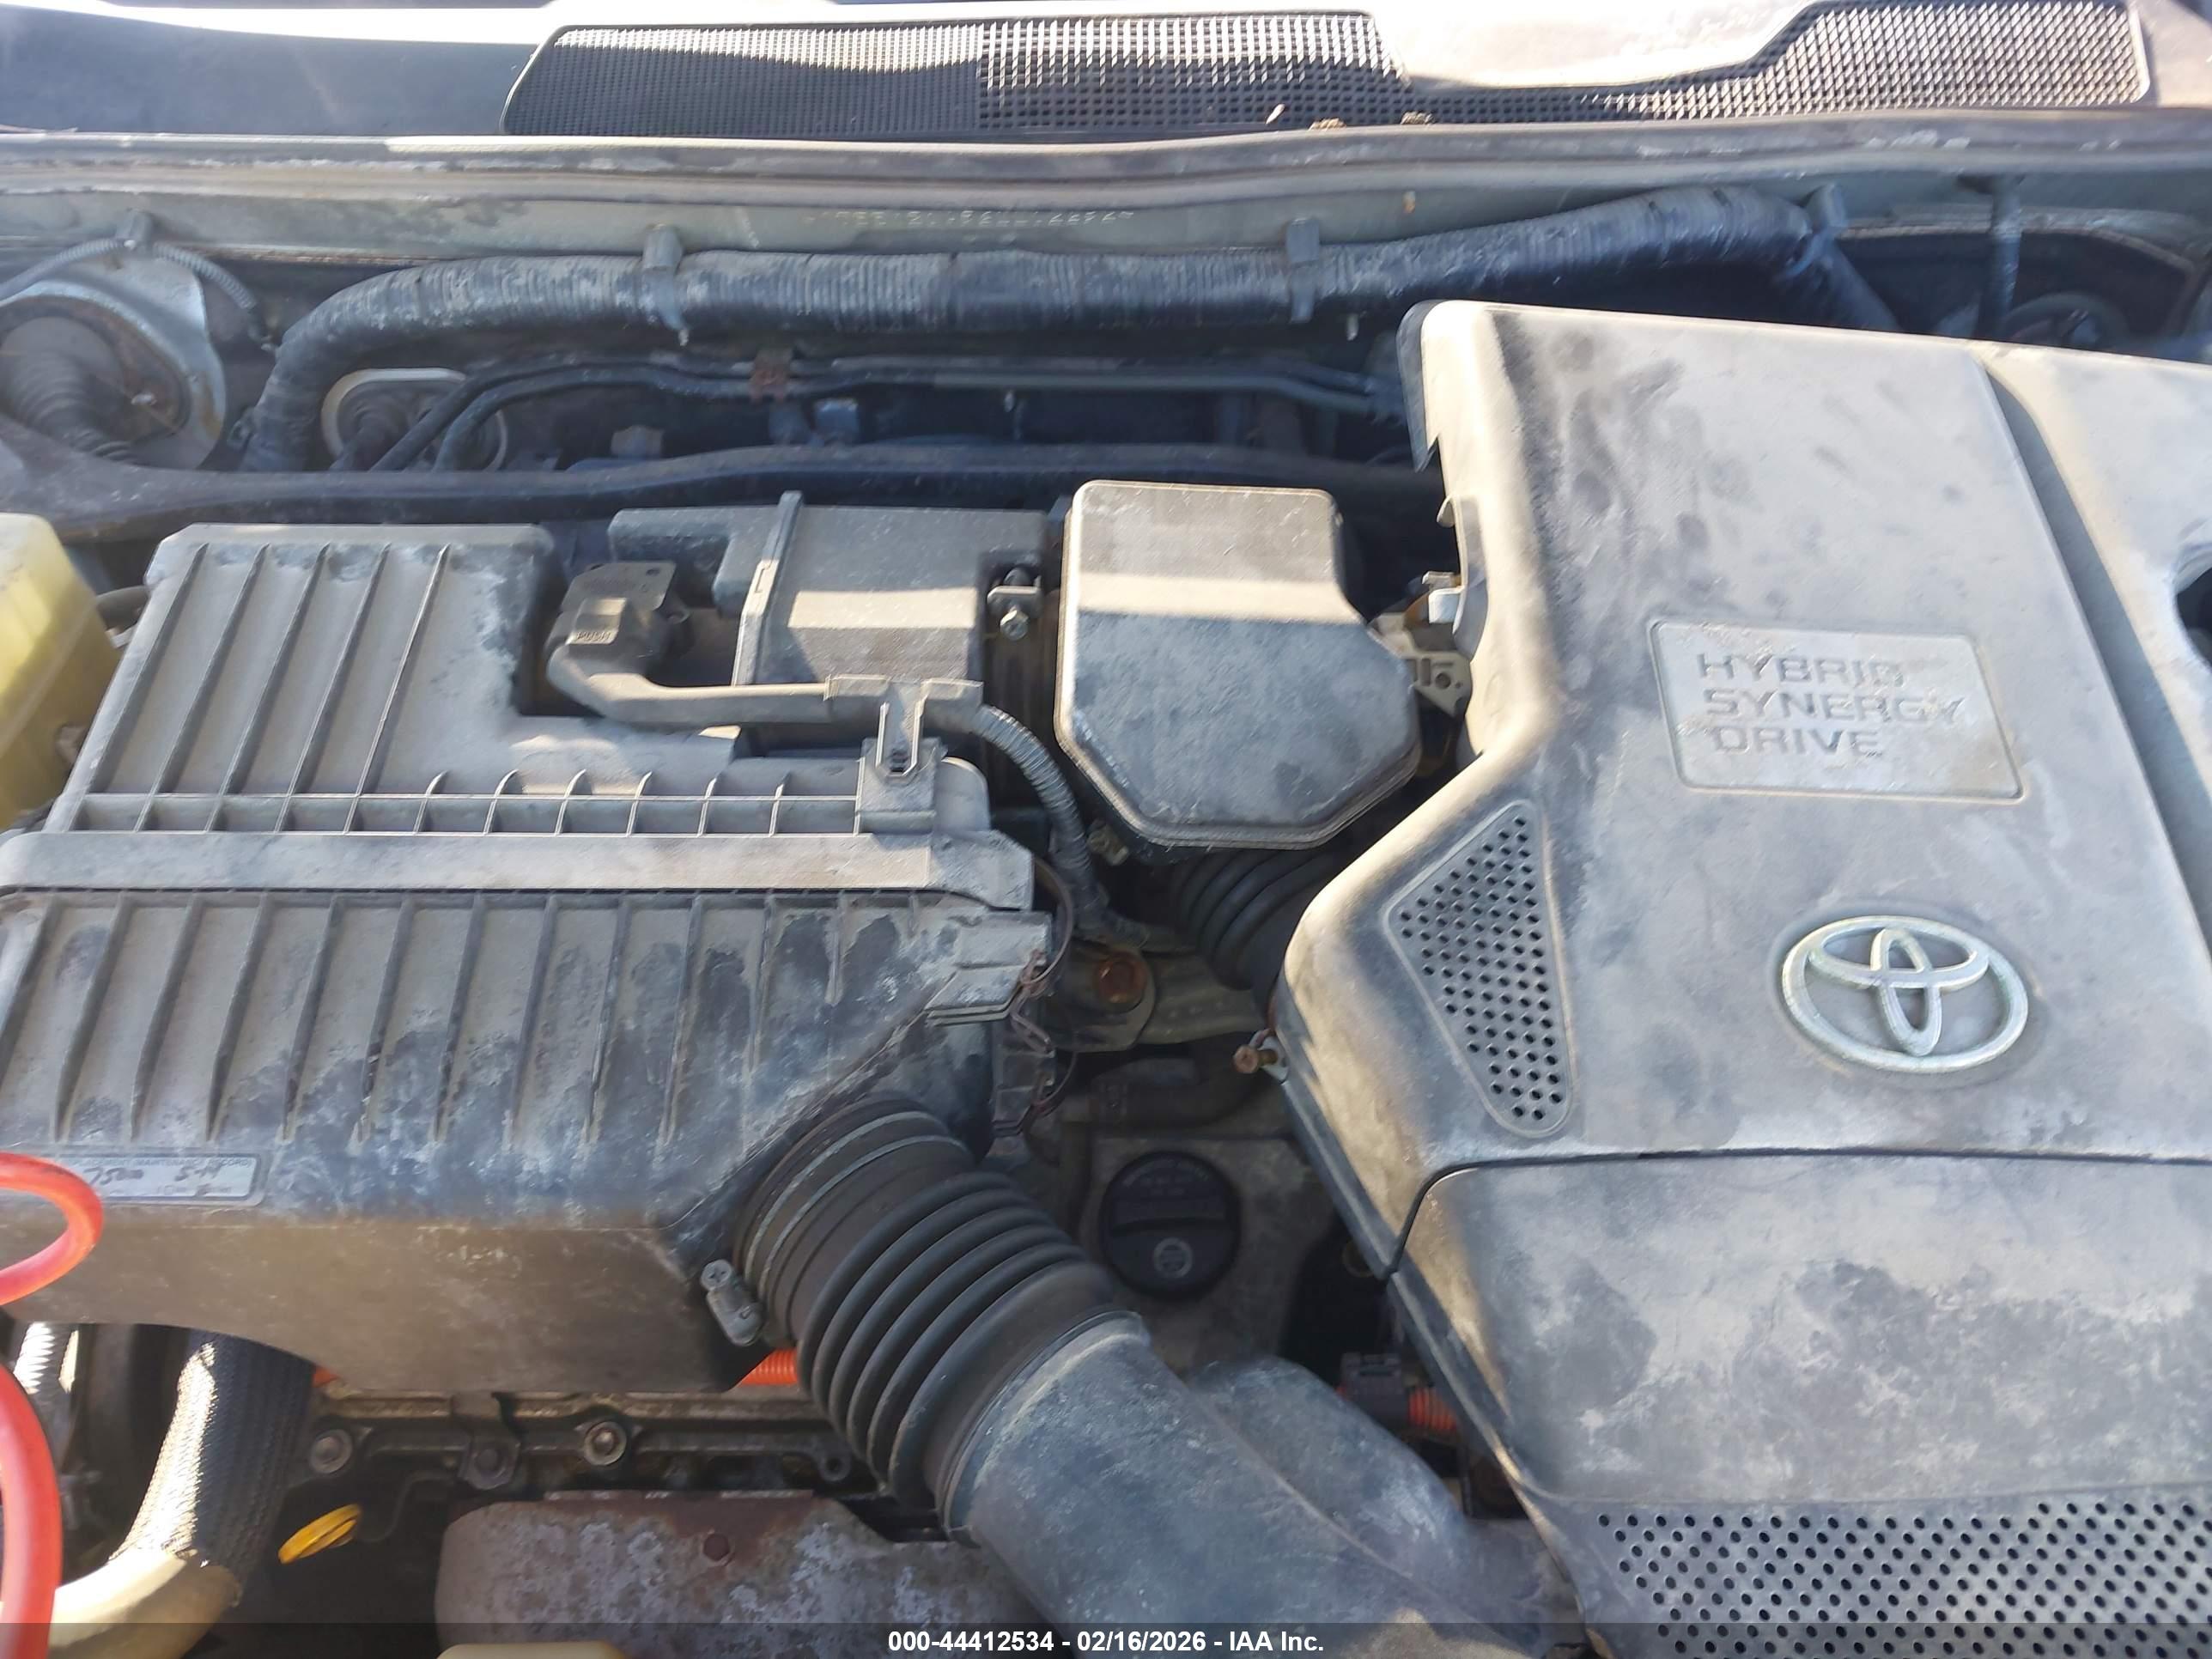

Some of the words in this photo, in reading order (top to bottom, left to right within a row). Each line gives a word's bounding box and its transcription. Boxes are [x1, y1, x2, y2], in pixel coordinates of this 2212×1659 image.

[1696, 653, 1905, 688] HYBRID
[1704, 687, 1965, 723] SYNERGY
[1712, 725, 1884, 757] DRIVE
